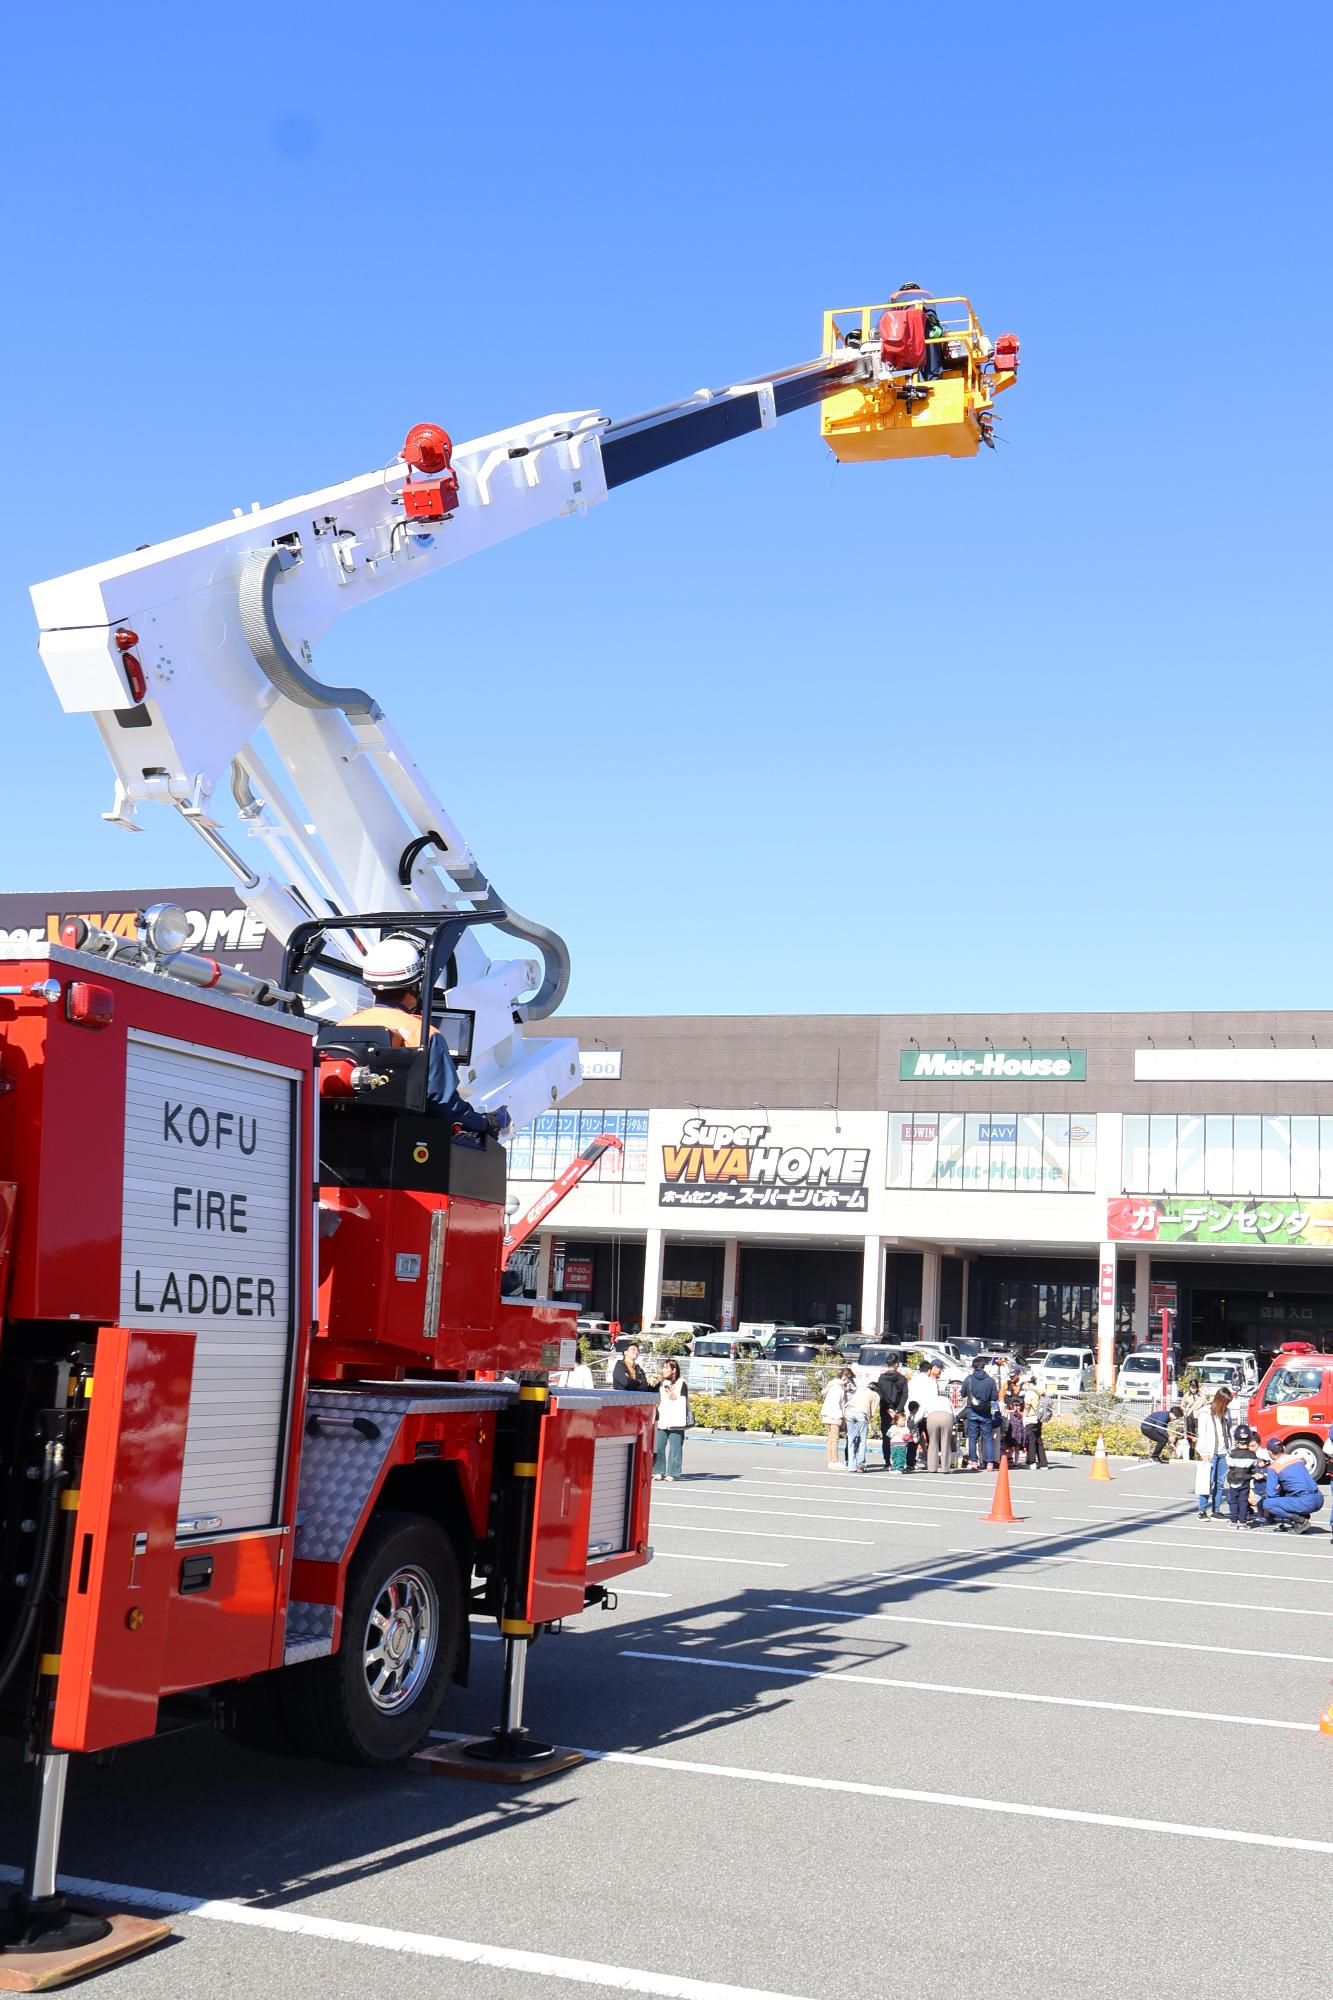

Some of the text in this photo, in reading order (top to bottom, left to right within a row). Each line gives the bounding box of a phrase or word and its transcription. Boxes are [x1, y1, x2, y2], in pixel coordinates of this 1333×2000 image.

[913, 1053, 1071, 1076] Mac-House
[163, 1101, 257, 1155] KOFU
[680, 1118, 768, 1148] Super
[904, 1127, 936, 1139] EDWIN
[981, 1128, 1015, 1139] NAVY
[662, 1145, 870, 1187] VIVAHOME
[931, 1160, 1063, 1182] Mac-House
[173, 1186, 248, 1233] FIRE
[662, 1187, 865, 1209] ホームセンター スーパービバホーム
[1131, 1206, 1333, 1236] ガーデンセンター
[135, 1270, 276, 1317] LADDER
